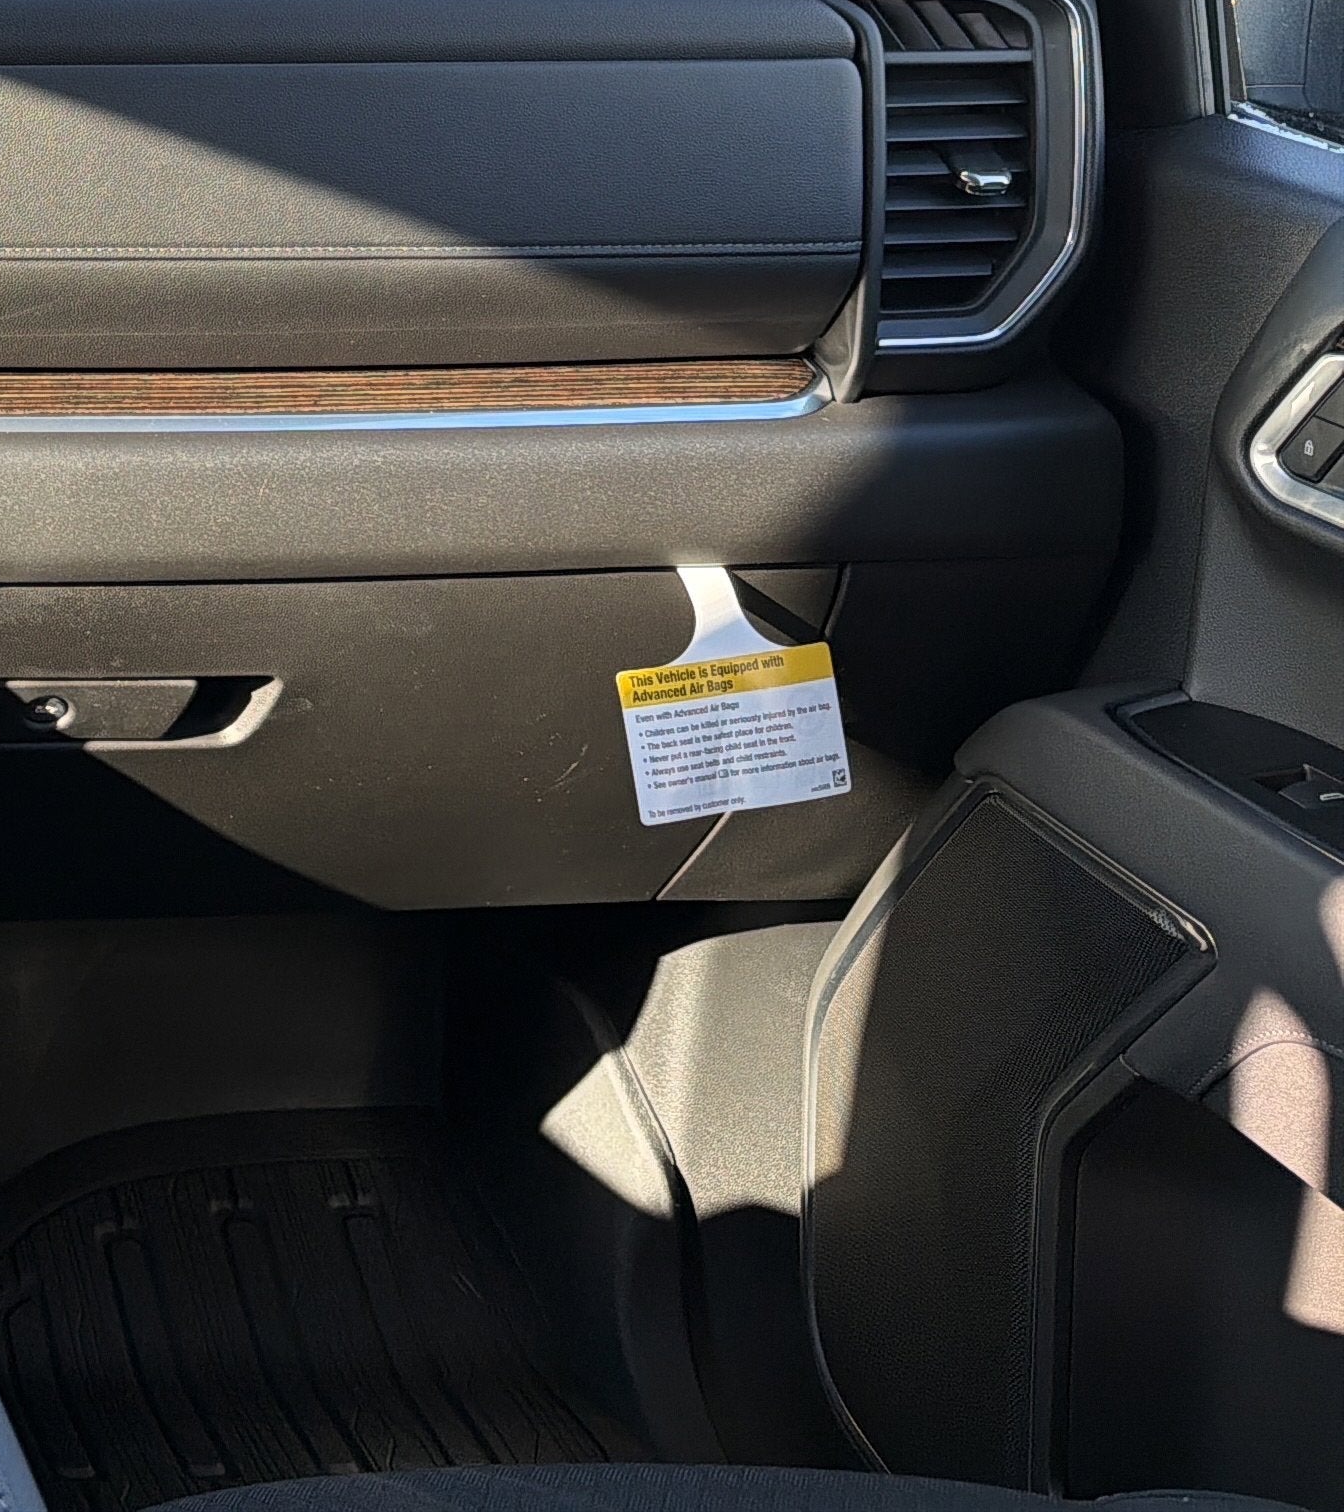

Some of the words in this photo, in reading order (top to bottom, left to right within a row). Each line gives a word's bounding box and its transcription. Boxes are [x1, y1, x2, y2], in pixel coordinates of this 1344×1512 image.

[629, 674, 653, 688] This
[655, 668, 696, 685] Vehicle
[697, 665, 709, 679] is
[710, 658, 759, 677] Equipped
[761, 655, 784, 669] with
[632, 683, 687, 704] Advanced
[689, 681, 705, 696] Air
[707, 679, 734, 693] Bags
[635, 714, 655, 724] Even
[656, 711, 672, 721] with
[674, 706, 709, 719] Advanced
[710, 703, 720, 713] Air
[720, 701, 740, 712] Bags
[648, 809, 657, 819] To
[657, 809, 666, 818] be
[667, 805, 693, 816] removed
[694, 803, 702, 814] by
[702, 798, 730, 810] customer
